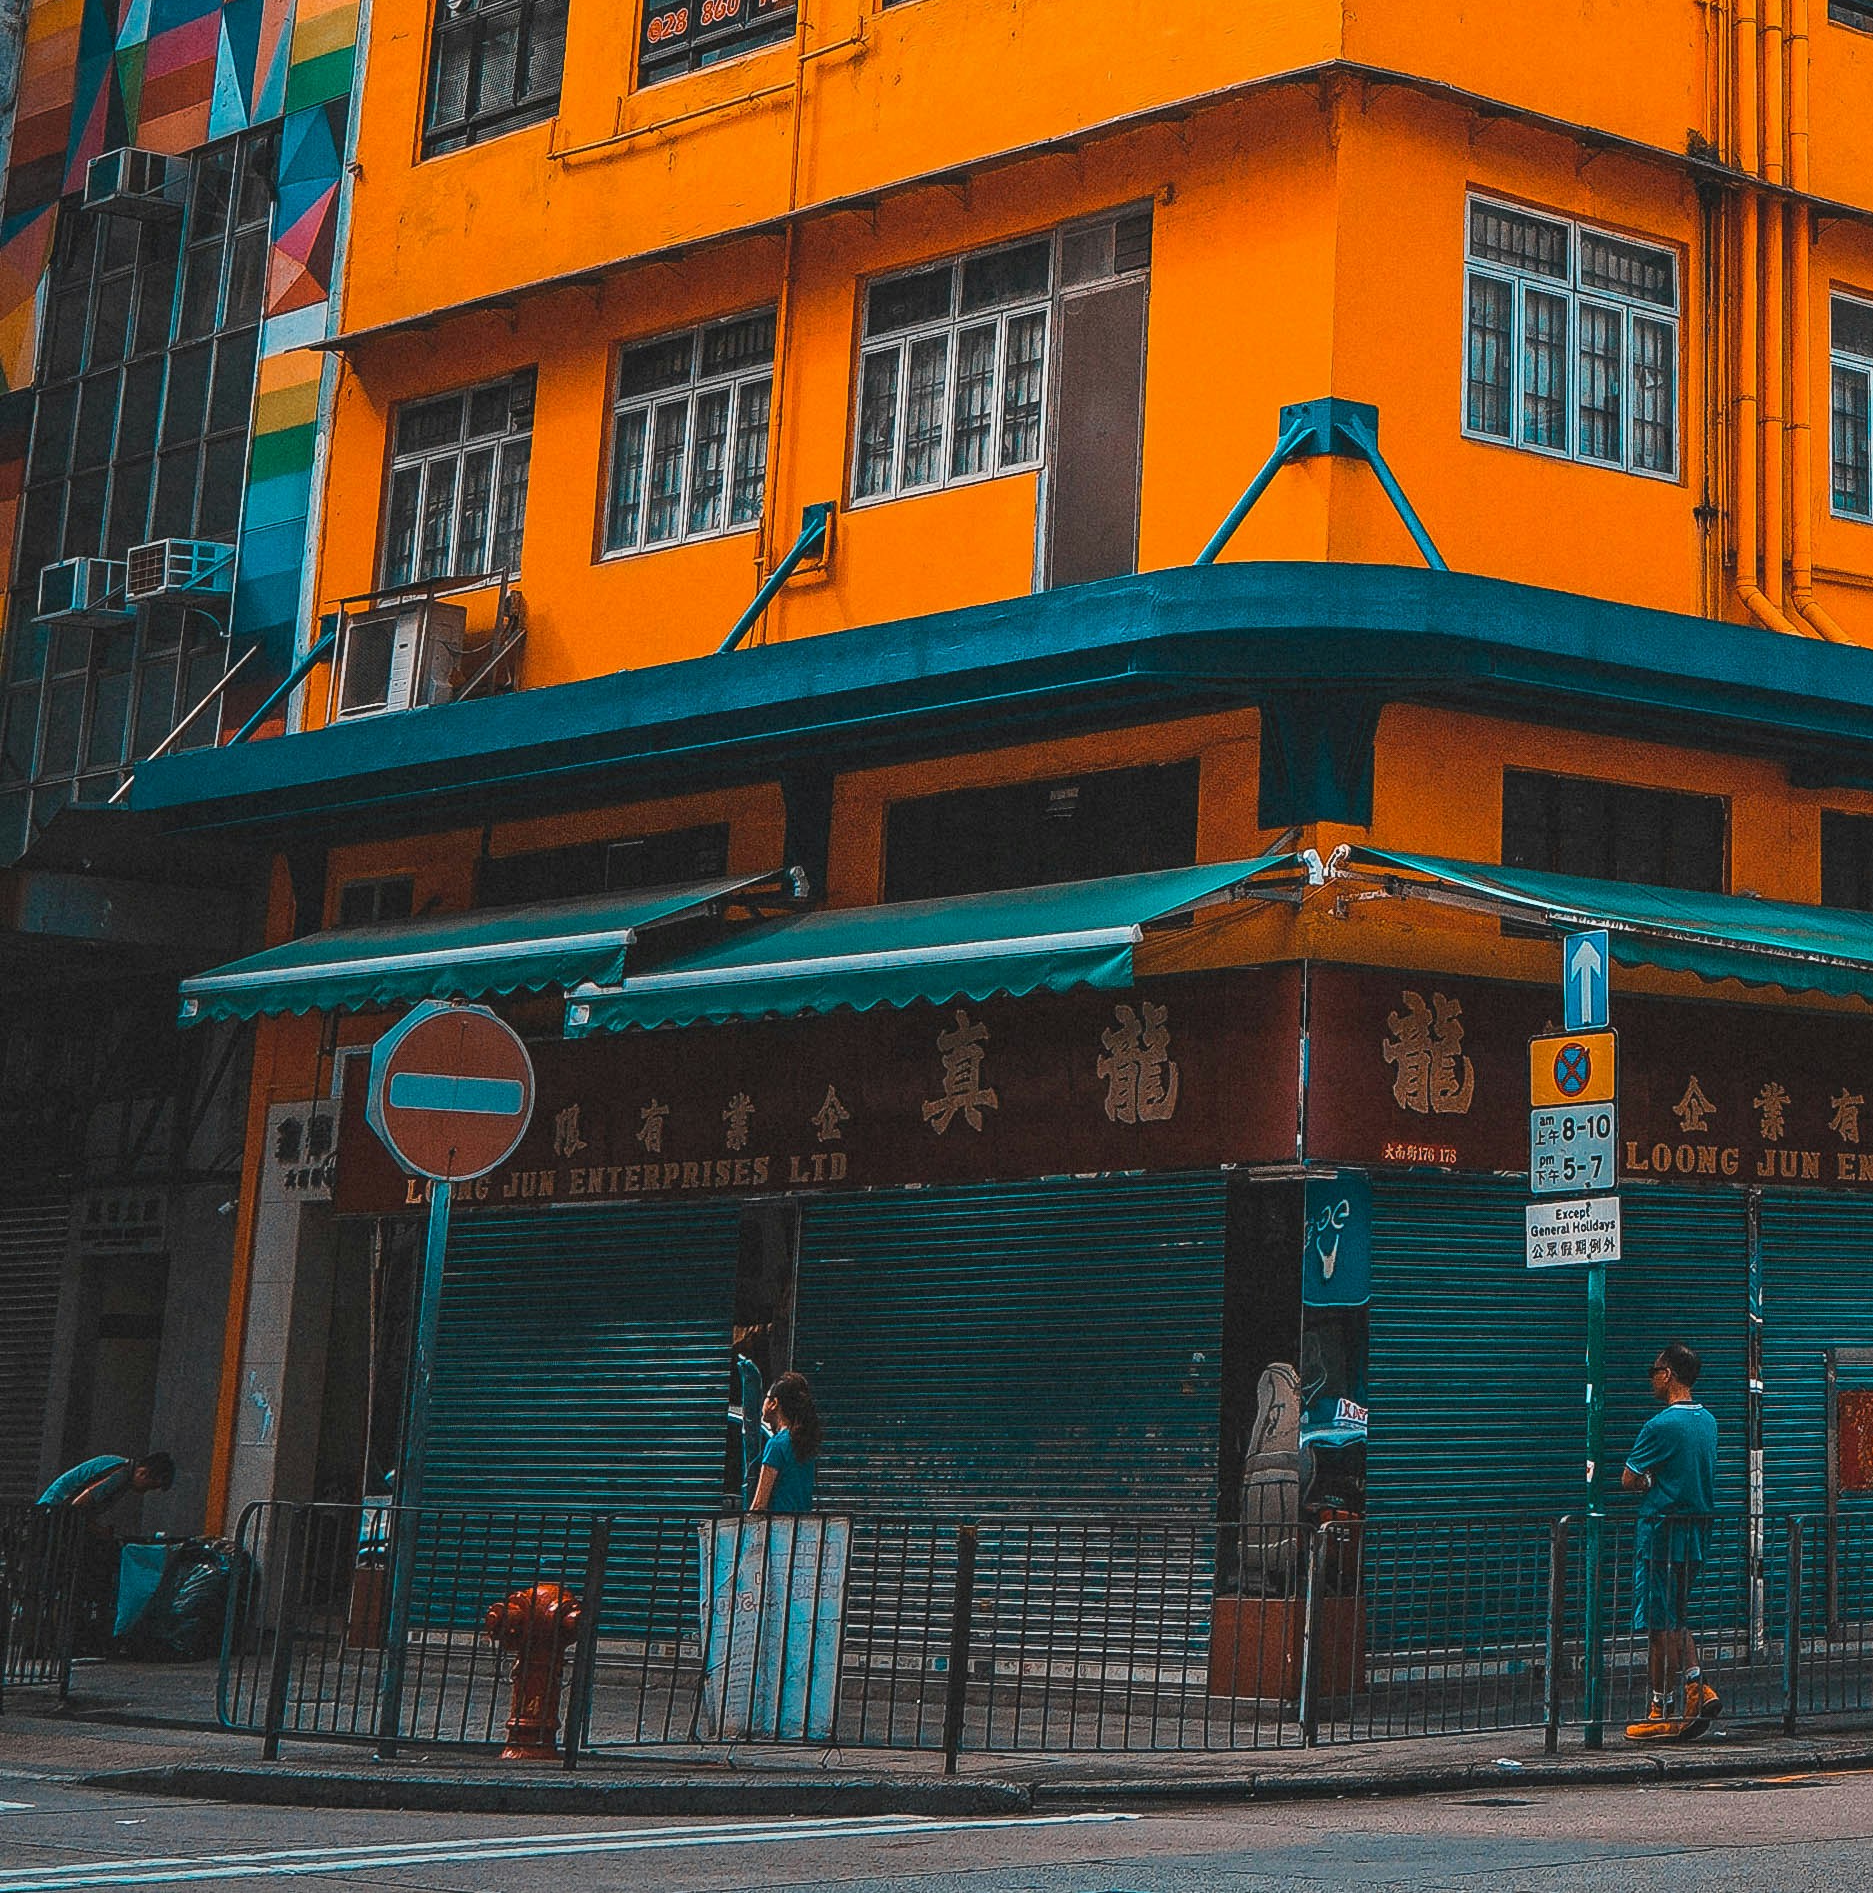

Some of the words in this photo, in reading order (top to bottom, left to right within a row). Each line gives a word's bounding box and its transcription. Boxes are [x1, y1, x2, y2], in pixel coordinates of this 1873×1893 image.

[1383, 989, 1475, 1116] 龍
[1534, 1128, 1560, 1146] 上午
[1539, 1115, 1555, 1127] am
[1562, 1114, 1611, 1142] 8-10
[1539, 1155, 1555, 1168] pm
[1626, 1141, 1740, 1174] LOONG
[1757, 1148, 1822, 1180] JUN
[405, 1175, 491, 1204] LNG
[503, 1169, 557, 1198] JUN
[569, 1155, 771, 1196] ENTERPRISES
[788, 1151, 848, 1184] LTD
[1534, 1169, 1560, 1186] 下午
[1555, 1205, 1591, 1220] Except
[1530, 1222, 1570, 1237] General
[1572, 1219, 1616, 1233] Holidays
